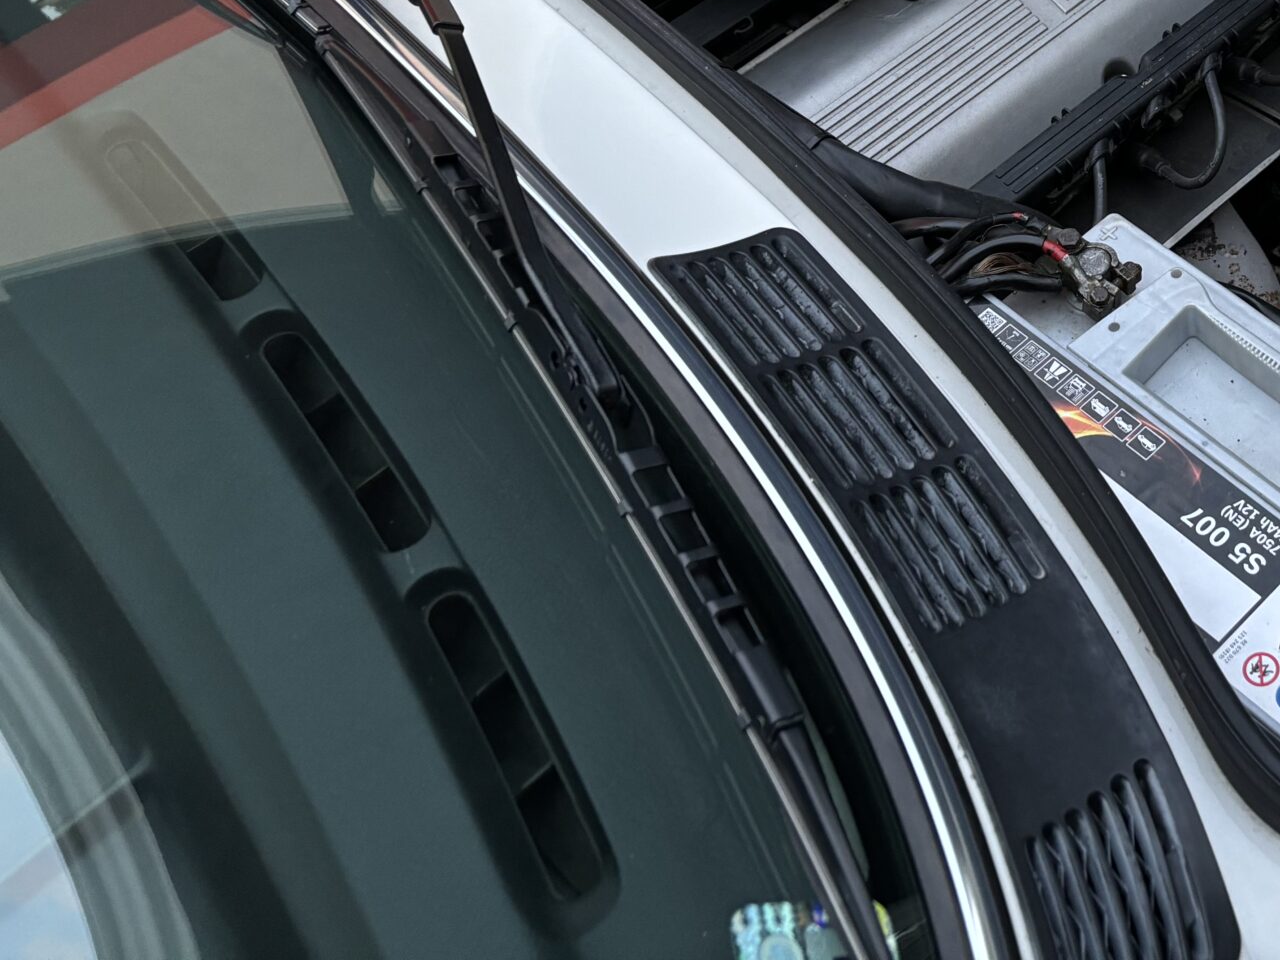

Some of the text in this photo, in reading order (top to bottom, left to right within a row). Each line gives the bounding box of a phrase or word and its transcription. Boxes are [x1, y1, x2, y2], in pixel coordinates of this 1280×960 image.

[1220, 504, 1280, 556] 750A (EN)
[1232, 499, 1260, 519] 12V
[1179, 507, 1266, 574] S5 007
